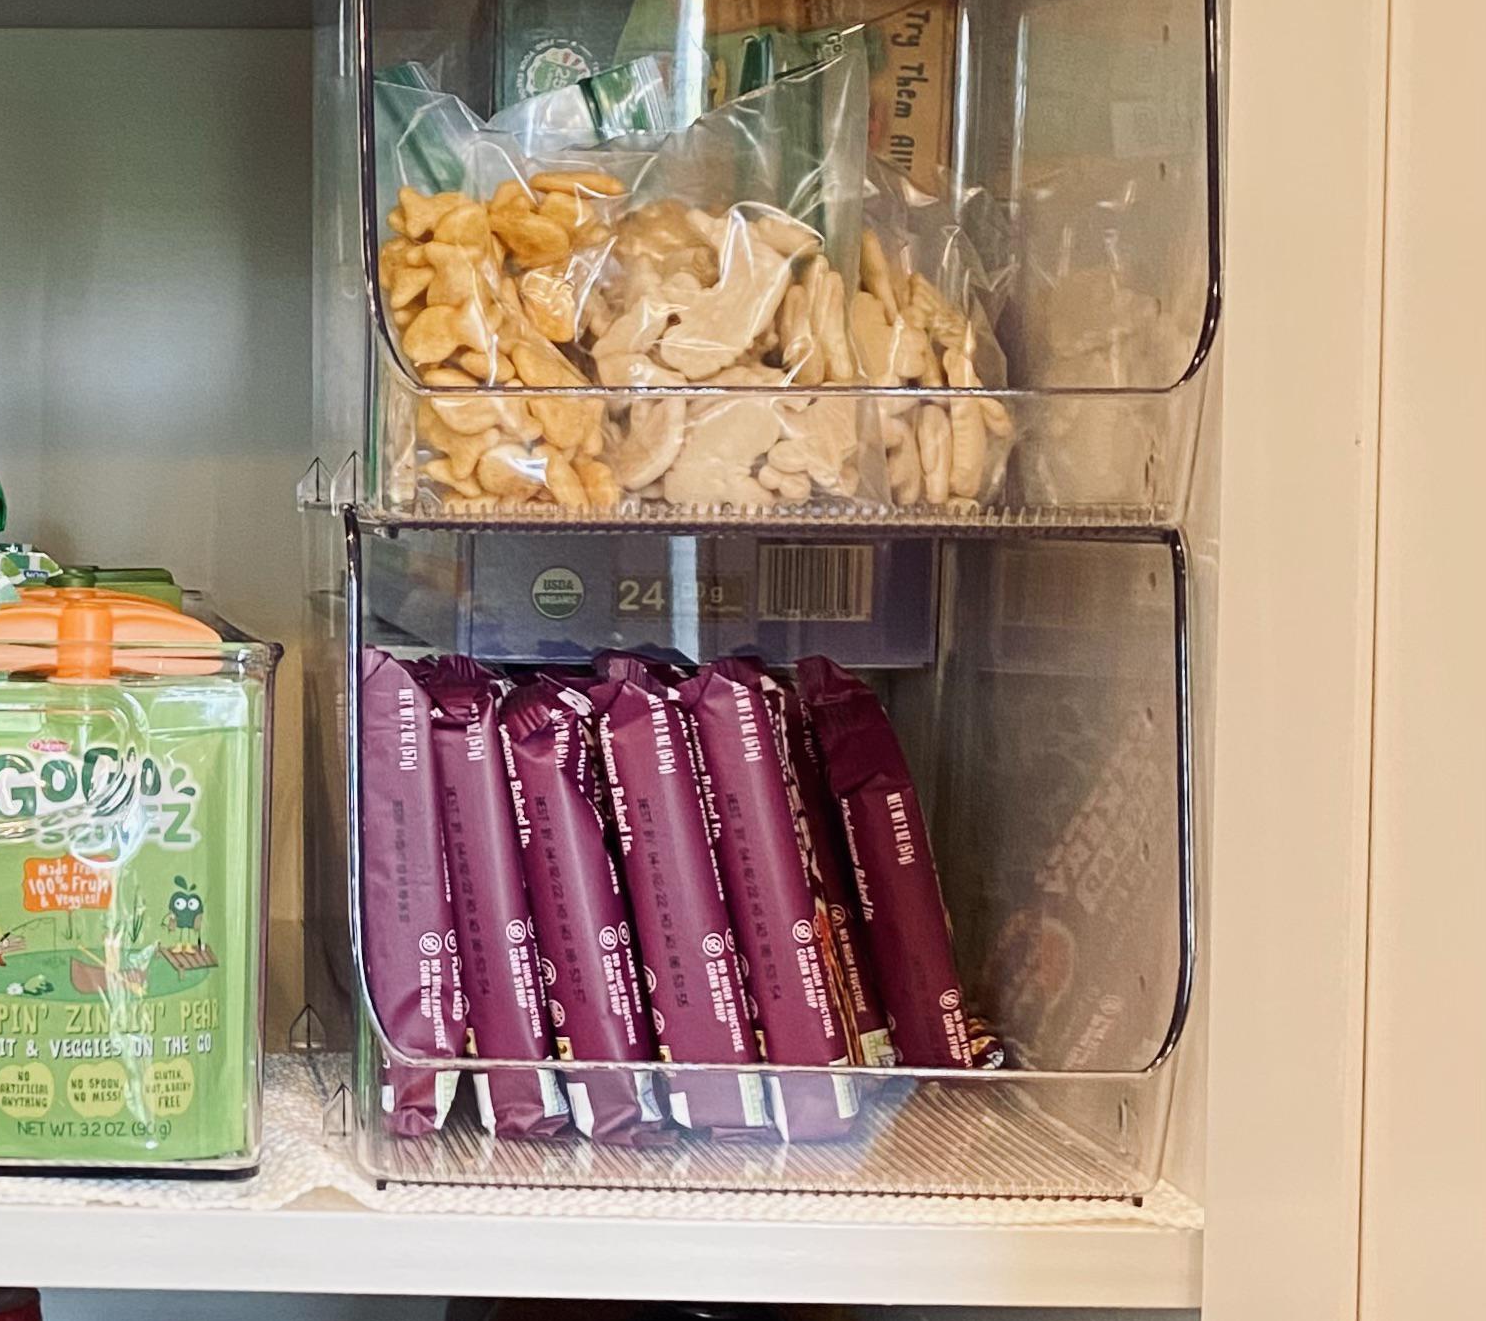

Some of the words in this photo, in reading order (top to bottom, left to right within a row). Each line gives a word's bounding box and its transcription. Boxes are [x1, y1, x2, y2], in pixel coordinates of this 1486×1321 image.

[891, 10, 930, 47] Try
[894, 63, 929, 119] Them
[543, 579, 574, 592] USDA
[619, 580, 665, 611] 24
[398, 688, 412, 706] NET
[400, 707, 413, 721] WT
[402, 731, 416, 744] OZ
[399, 745, 418, 771] (57g)
[611, 787, 629, 833] Baked
[619, 835, 633, 856] In.
[716, 959, 726, 974] NO
[705, 961, 718, 988] CORN
[712, 990, 726, 1022] SYRUP
[720, 976, 732, 999] HIGH
[66, 1003, 165, 1034] ZININ'
[723, 1000, 743, 1052] FRUCTOSE
[26, 1043, 39, 1057] &
[50, 1037, 122, 1058] VEGGIES
[134, 1038, 154, 1057] ON
[164, 1035, 189, 1054] THE
[197, 1033, 211, 1053] GO
[18, 1122, 45, 1135] NET
[104, 1122, 126, 1136] OZ
